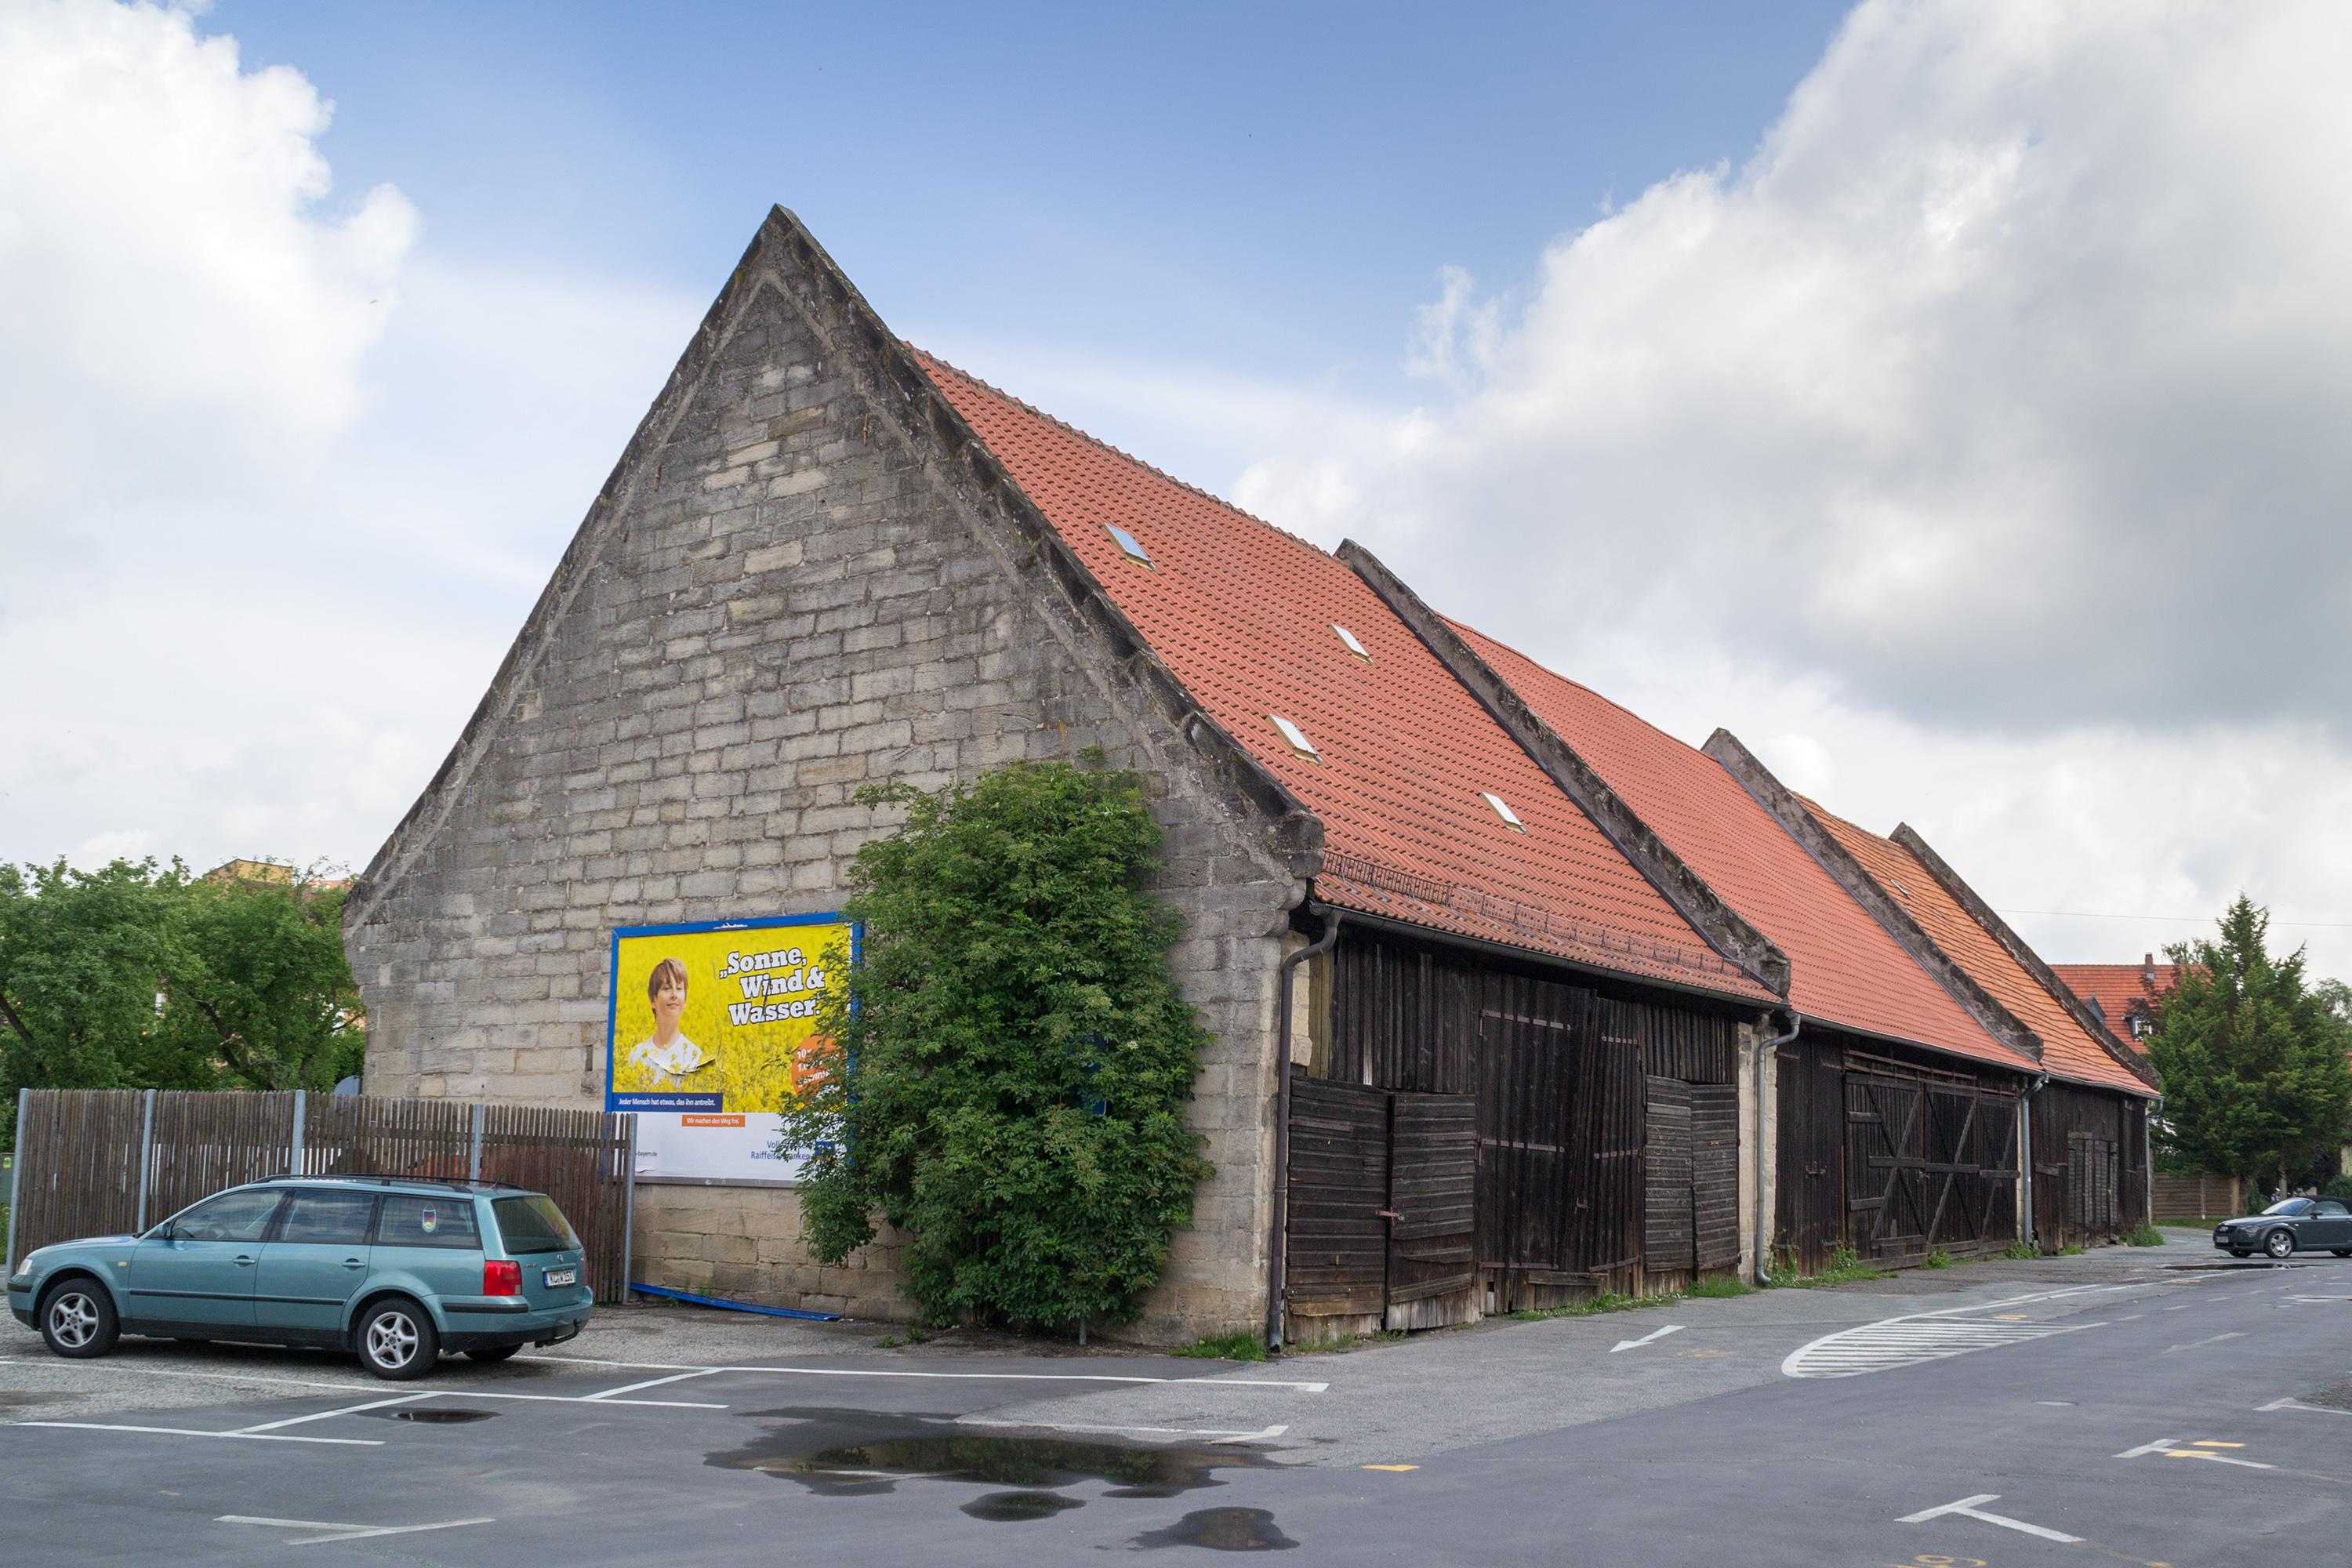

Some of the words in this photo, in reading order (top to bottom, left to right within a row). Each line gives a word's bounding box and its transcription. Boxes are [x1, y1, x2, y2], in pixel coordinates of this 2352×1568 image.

[740, 968, 804, 999] Wind
[805, 965, 826, 990] &
[720, 1117, 731, 1126] Weg
